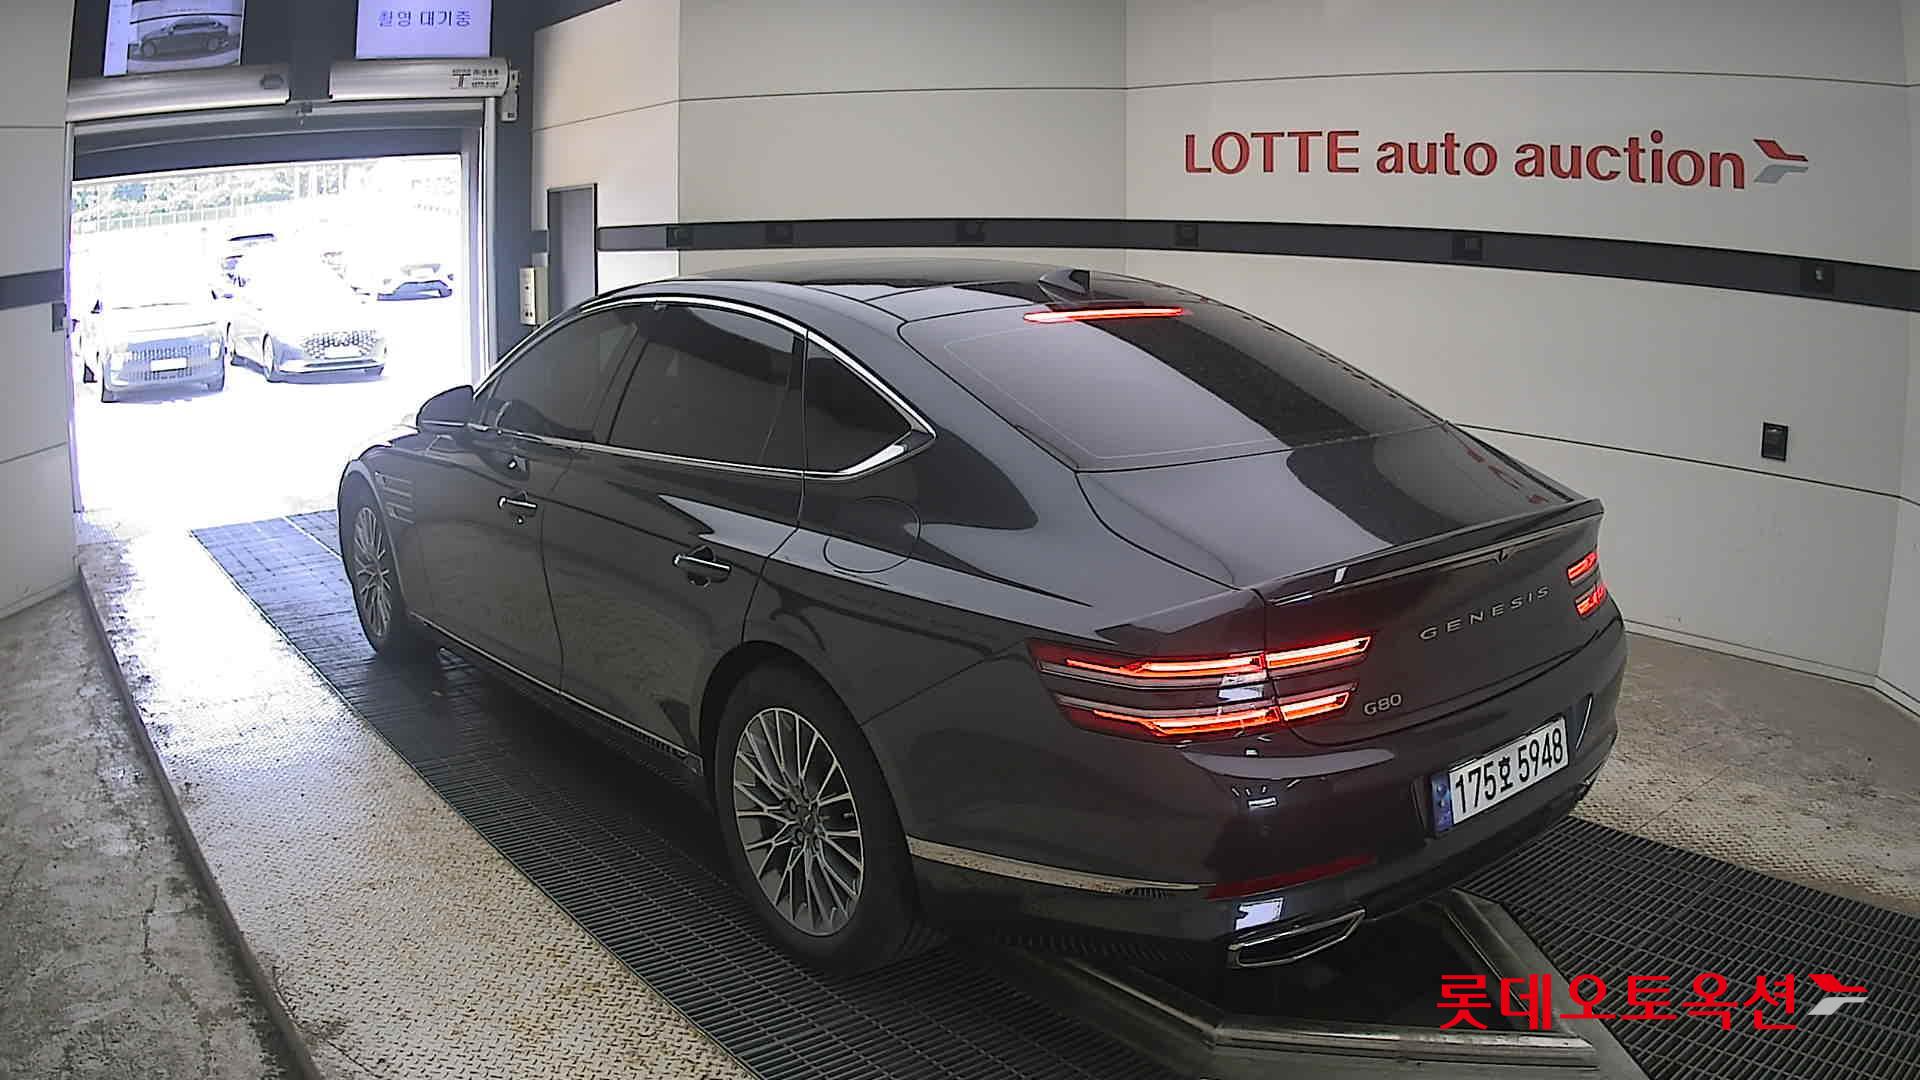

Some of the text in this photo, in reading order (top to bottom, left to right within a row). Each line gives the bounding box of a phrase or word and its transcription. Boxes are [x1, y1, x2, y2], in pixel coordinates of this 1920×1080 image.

[420, 10, 471, 27] 대기중
[1185, 130, 1746, 189] LOTTE auto auction
[1419, 586, 1550, 641] GENESIS
[1363, 694, 1403, 716] G80
